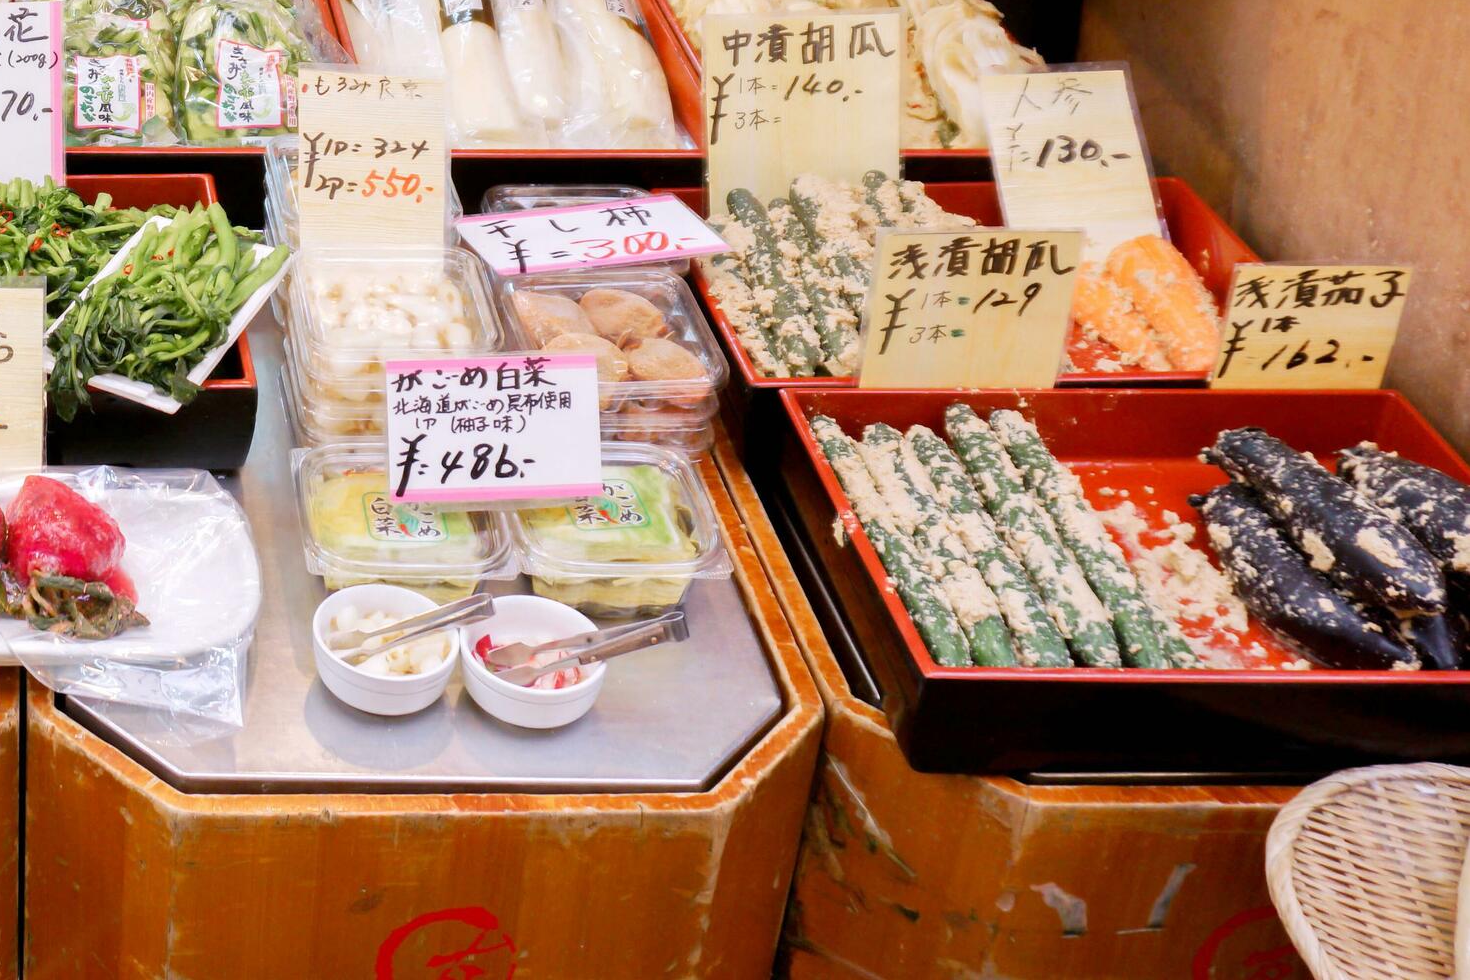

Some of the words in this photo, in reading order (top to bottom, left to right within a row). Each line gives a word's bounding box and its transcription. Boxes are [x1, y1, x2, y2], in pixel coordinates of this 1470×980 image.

[722, 21, 896, 67] 中漬胡瓜
[481, 203, 652, 239] 干し柿
[887, 236, 1076, 279] 浅漬胡瓜
[1234, 269, 1405, 309] 浅漬茄子
[390, 357, 557, 393] がごめ白菜
[392, 391, 571, 416] 北海道がごめ昆布使用
